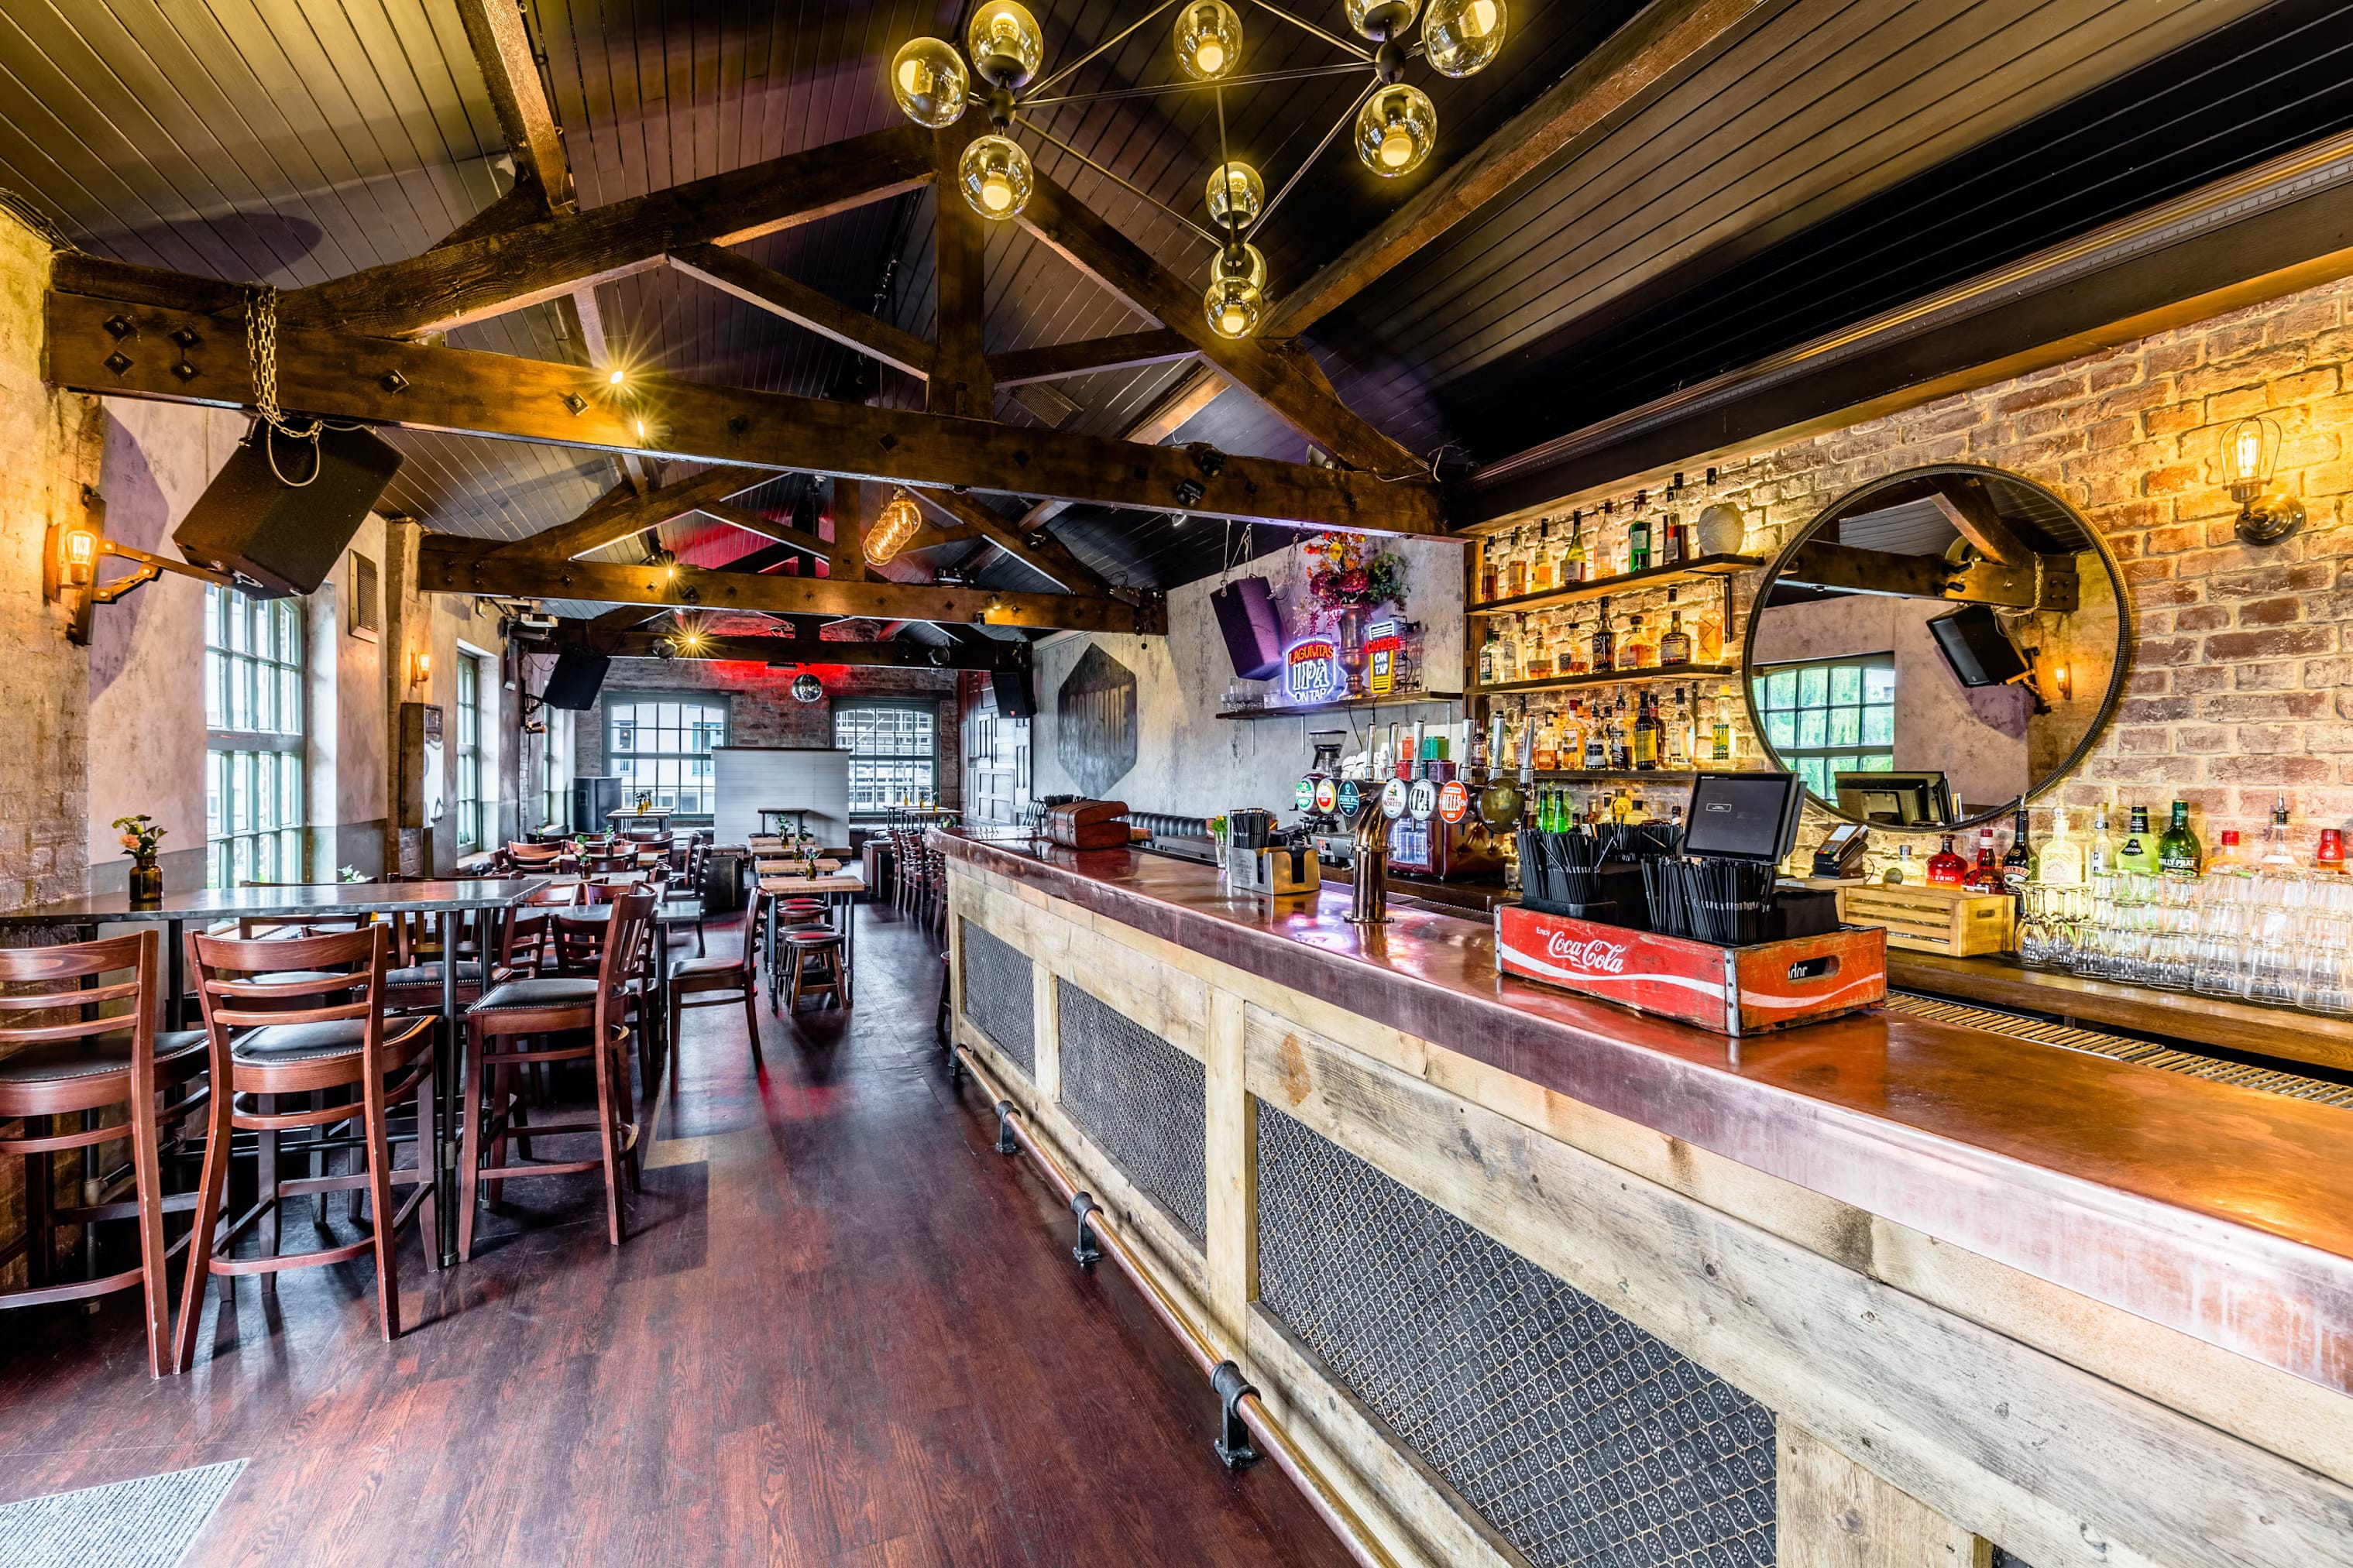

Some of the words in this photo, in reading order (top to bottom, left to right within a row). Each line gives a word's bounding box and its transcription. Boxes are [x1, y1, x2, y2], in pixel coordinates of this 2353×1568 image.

[1289, 644, 1334, 665] LAGUNITAS
[1374, 651, 1388, 663] ON
[1293, 658, 1330, 691] IPA
[1374, 664, 1389, 675] TAP
[1295, 691, 1309, 702] ON
[1309, 688, 1327, 702] TAP
[1410, 788, 1431, 811] IPA
[1442, 794, 1462, 811] HELLS
[2159, 857, 2176, 866] OILLY
[1536, 926, 1551, 937] Enjoy
[1549, 931, 1626, 973] Coca-Cola
